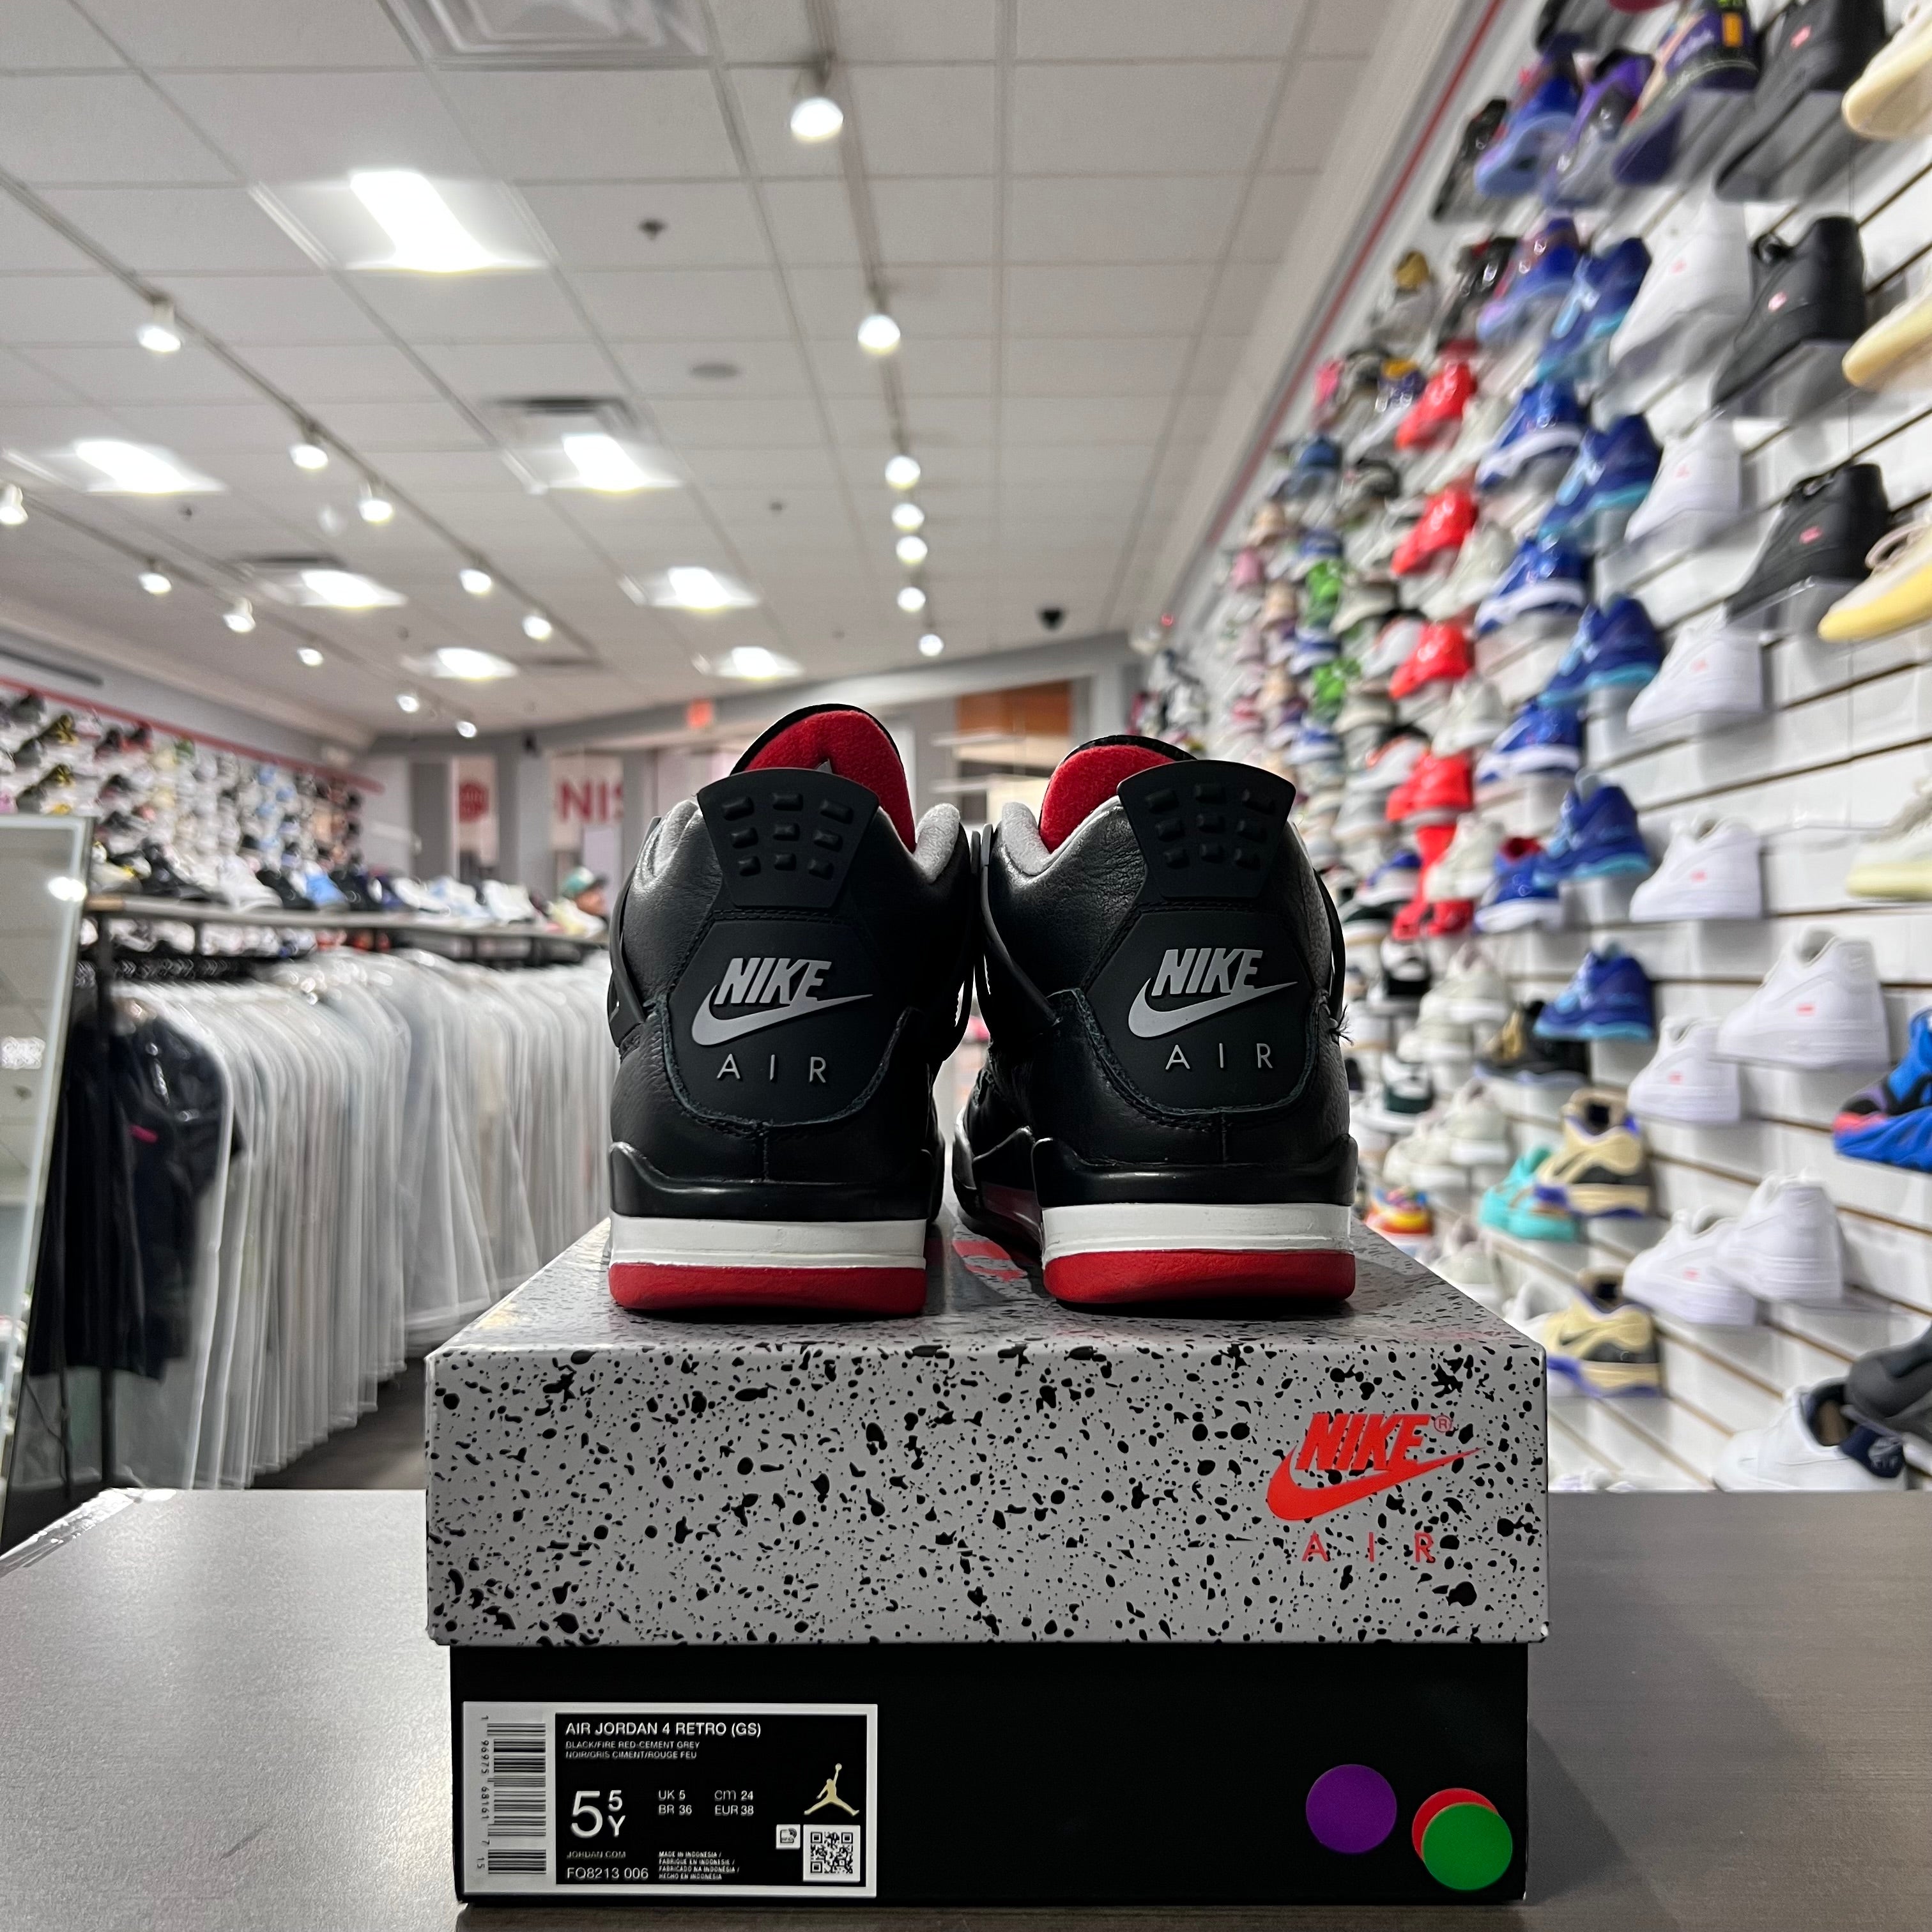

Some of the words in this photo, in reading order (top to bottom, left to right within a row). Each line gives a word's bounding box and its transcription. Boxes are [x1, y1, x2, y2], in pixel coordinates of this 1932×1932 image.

[714, 958, 832, 1006] NIKE
[1151, 947, 1263, 996] NIKE
[1165, 1043, 1273, 1070] AIR
[716, 1054, 827, 1083] AIR
[1301, 1531, 1436, 1563] AIR
[565, 1722, 590, 1735] AIR
[595, 1722, 657, 1735] JORDAN
[662, 1722, 670, 1735] 4
[675, 1722, 726, 1735] RETRO
[731, 1722, 761, 1738] (GS)
[565, 1741, 616, 1749] BLACK/FIRE
[677, 1741, 700, 1749] GREY
[481, 1740, 489, 1774] 96975
[481, 1786, 489, 1820] 68161
[608, 1790, 623, 1811] 5
[658, 1790, 675, 1801] UK
[678, 1790, 686, 1800] 5
[740, 1790, 754, 1800] 24
[571, 1791, 603, 1838] 5
[658, 1804, 675, 1815] BR
[678, 1804, 693, 1815] 36
[714, 1805, 739, 1816] EUR
[740, 1805, 754, 1816] 38
[608, 1815, 626, 1837] Y
[624, 1867, 648, 1880] 006
